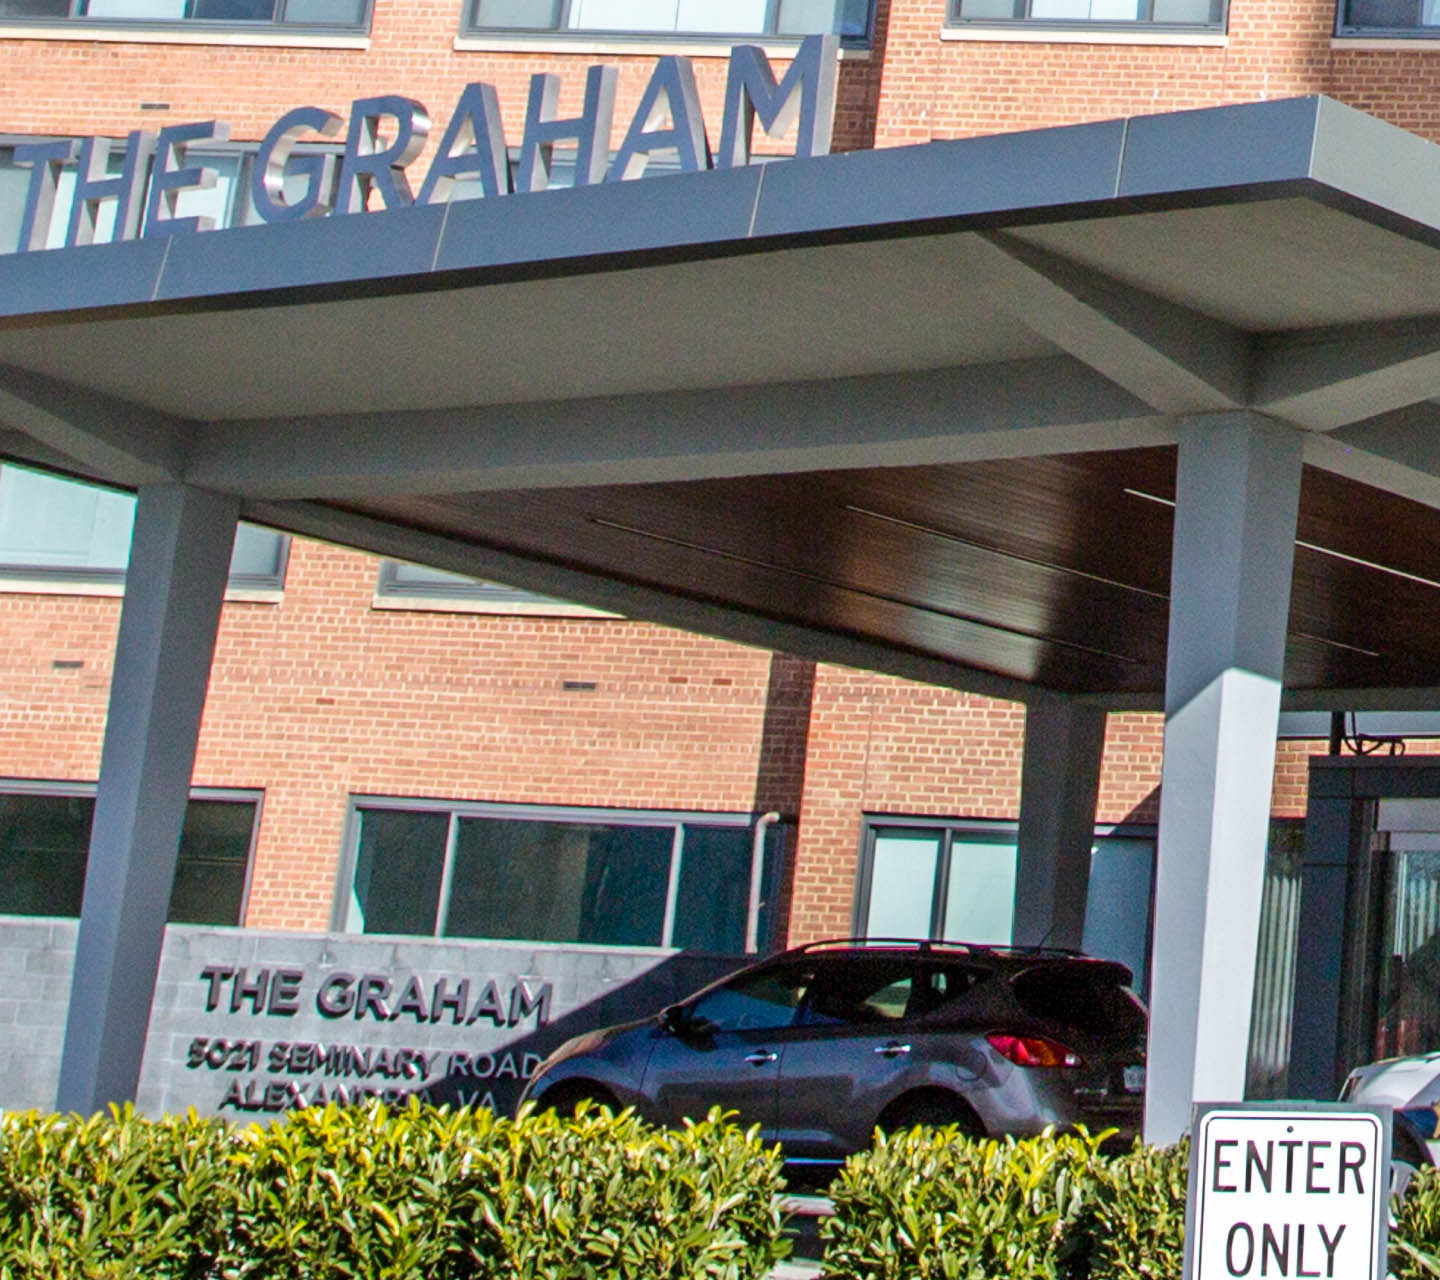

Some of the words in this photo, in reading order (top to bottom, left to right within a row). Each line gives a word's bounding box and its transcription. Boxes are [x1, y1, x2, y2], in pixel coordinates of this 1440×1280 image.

[14, 120, 231, 252] THE
[252, 35, 839, 222] GRAHAM
[200, 964, 305, 1015] THE
[316, 970, 556, 1028] GRAHAM
[187, 1038, 260, 1072] 5021
[267, 1042, 439, 1081] SEMINARY
[447, 1051, 541, 1080] ROAD
[1212, 1139, 1367, 1195] ENTER
[1225, 1222, 1347, 1278] ONLY
